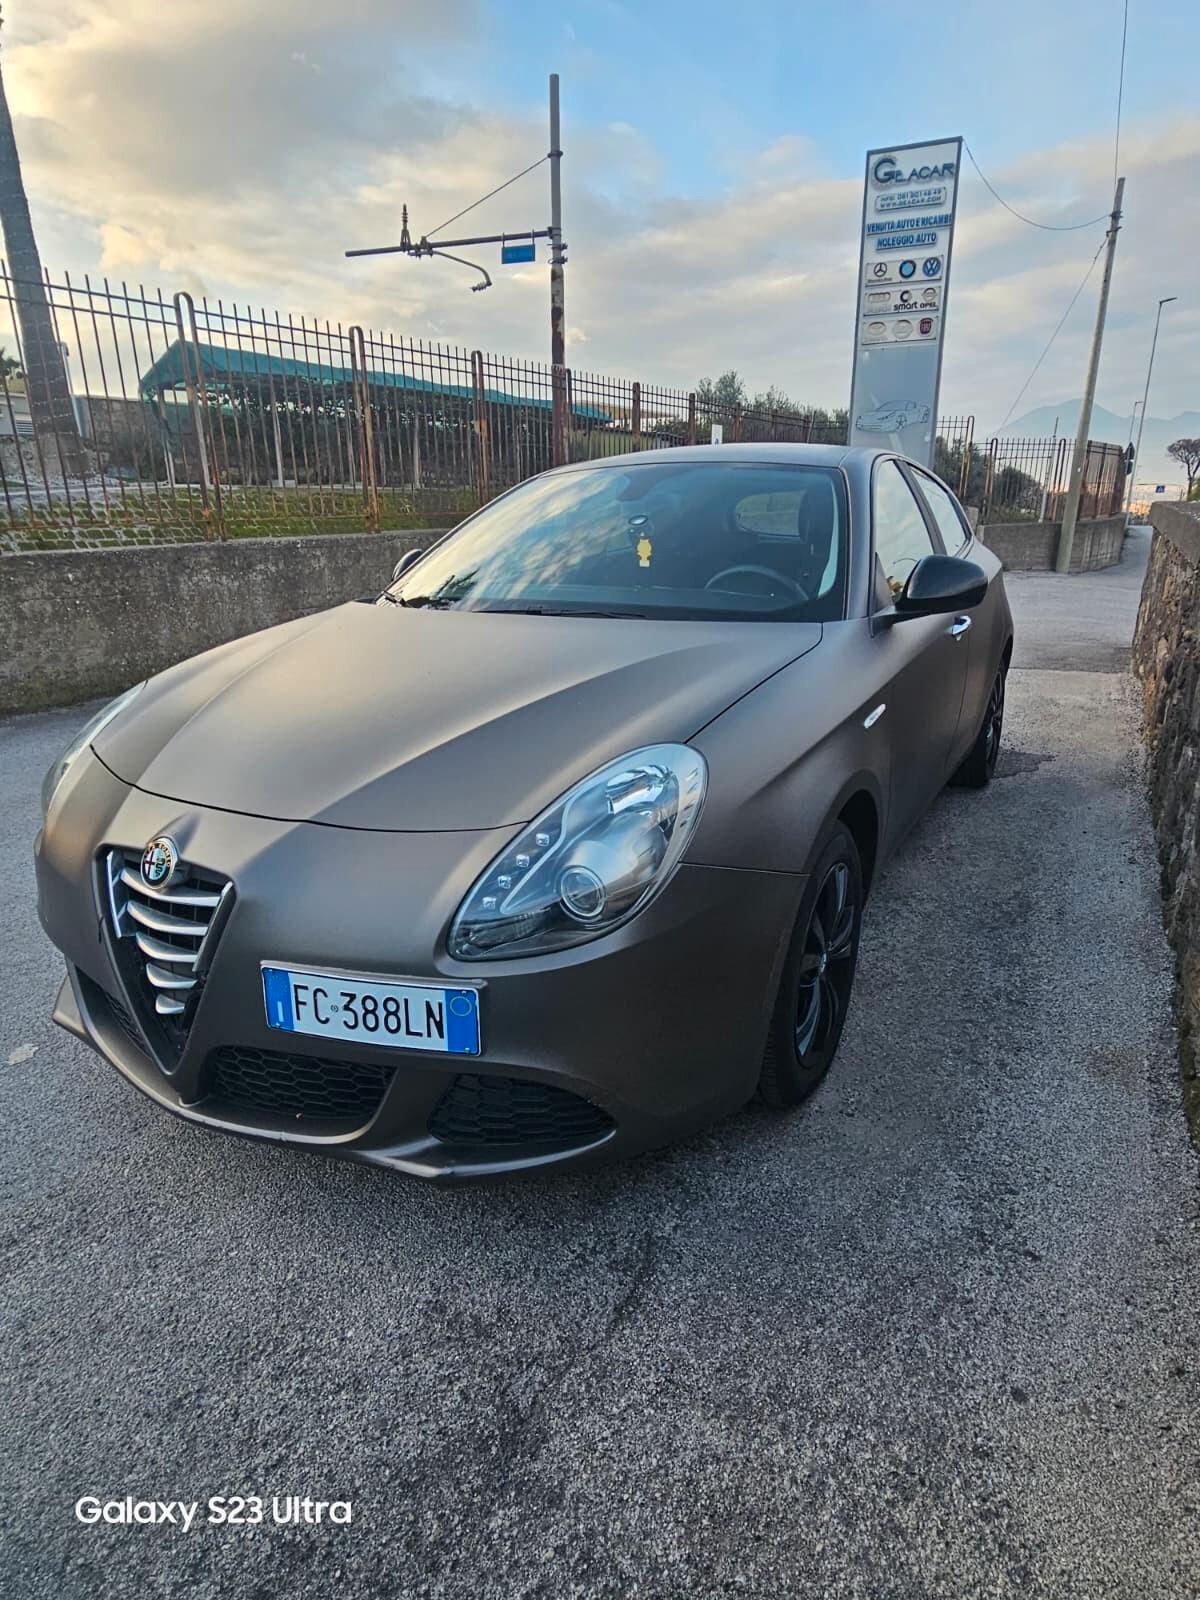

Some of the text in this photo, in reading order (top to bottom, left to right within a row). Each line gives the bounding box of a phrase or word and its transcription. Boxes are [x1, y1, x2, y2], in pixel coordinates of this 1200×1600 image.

[867, 213, 952, 233] VENDITA AUTO E RICAMBI
[877, 232, 937, 248] NOLEGGIO AUTO
[893, 301, 918, 311] smart
